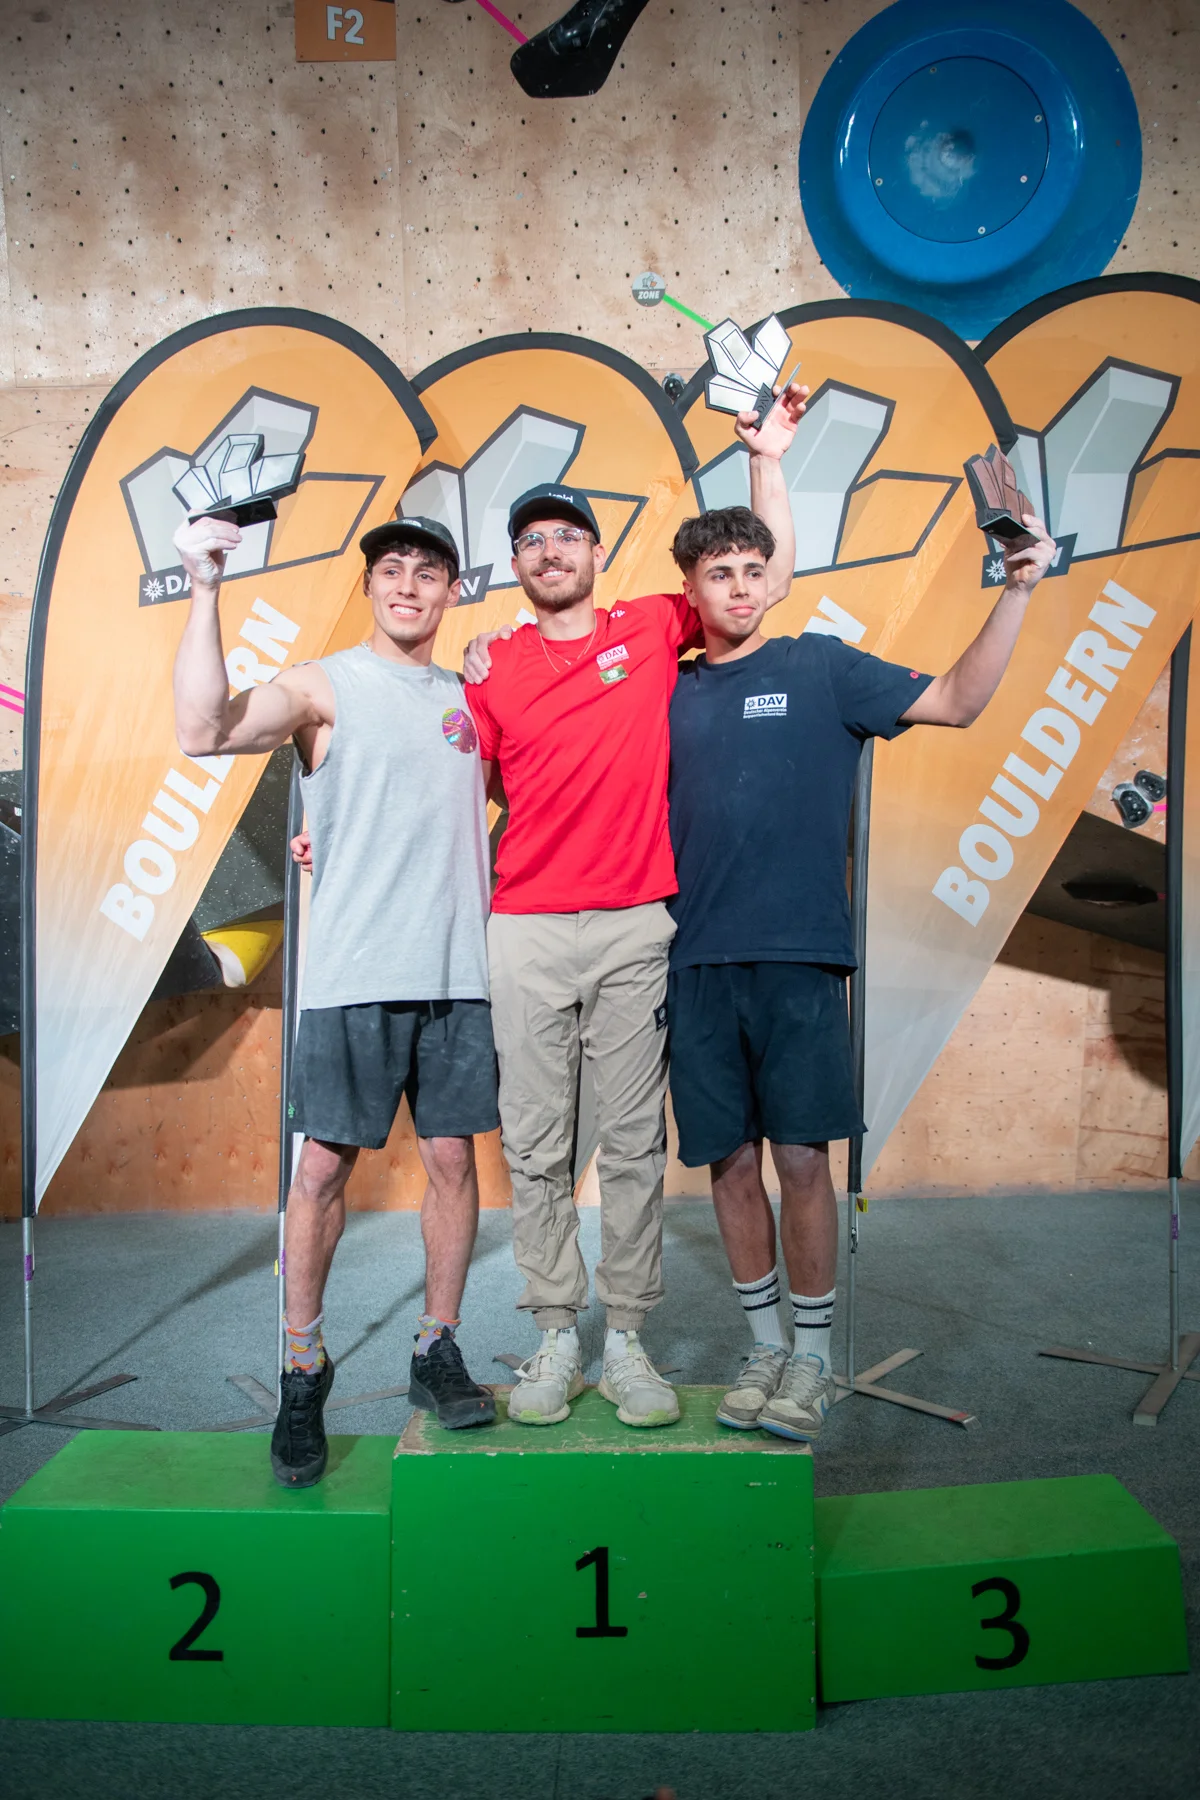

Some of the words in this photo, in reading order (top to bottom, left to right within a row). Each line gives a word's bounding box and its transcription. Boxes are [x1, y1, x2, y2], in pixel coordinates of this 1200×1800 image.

[326, 5, 364, 45] F2
[637, 290, 661, 300] ZONE
[605, 646, 624, 660] DAV
[757, 696, 785, 707] DAV
[99, 597, 300, 942] BOULRN
[932, 579, 1157, 927] BOULDERN
[168, 1571, 224, 1661] 2
[576, 1546, 628, 1638] 1
[971, 1577, 1030, 1670] 3
